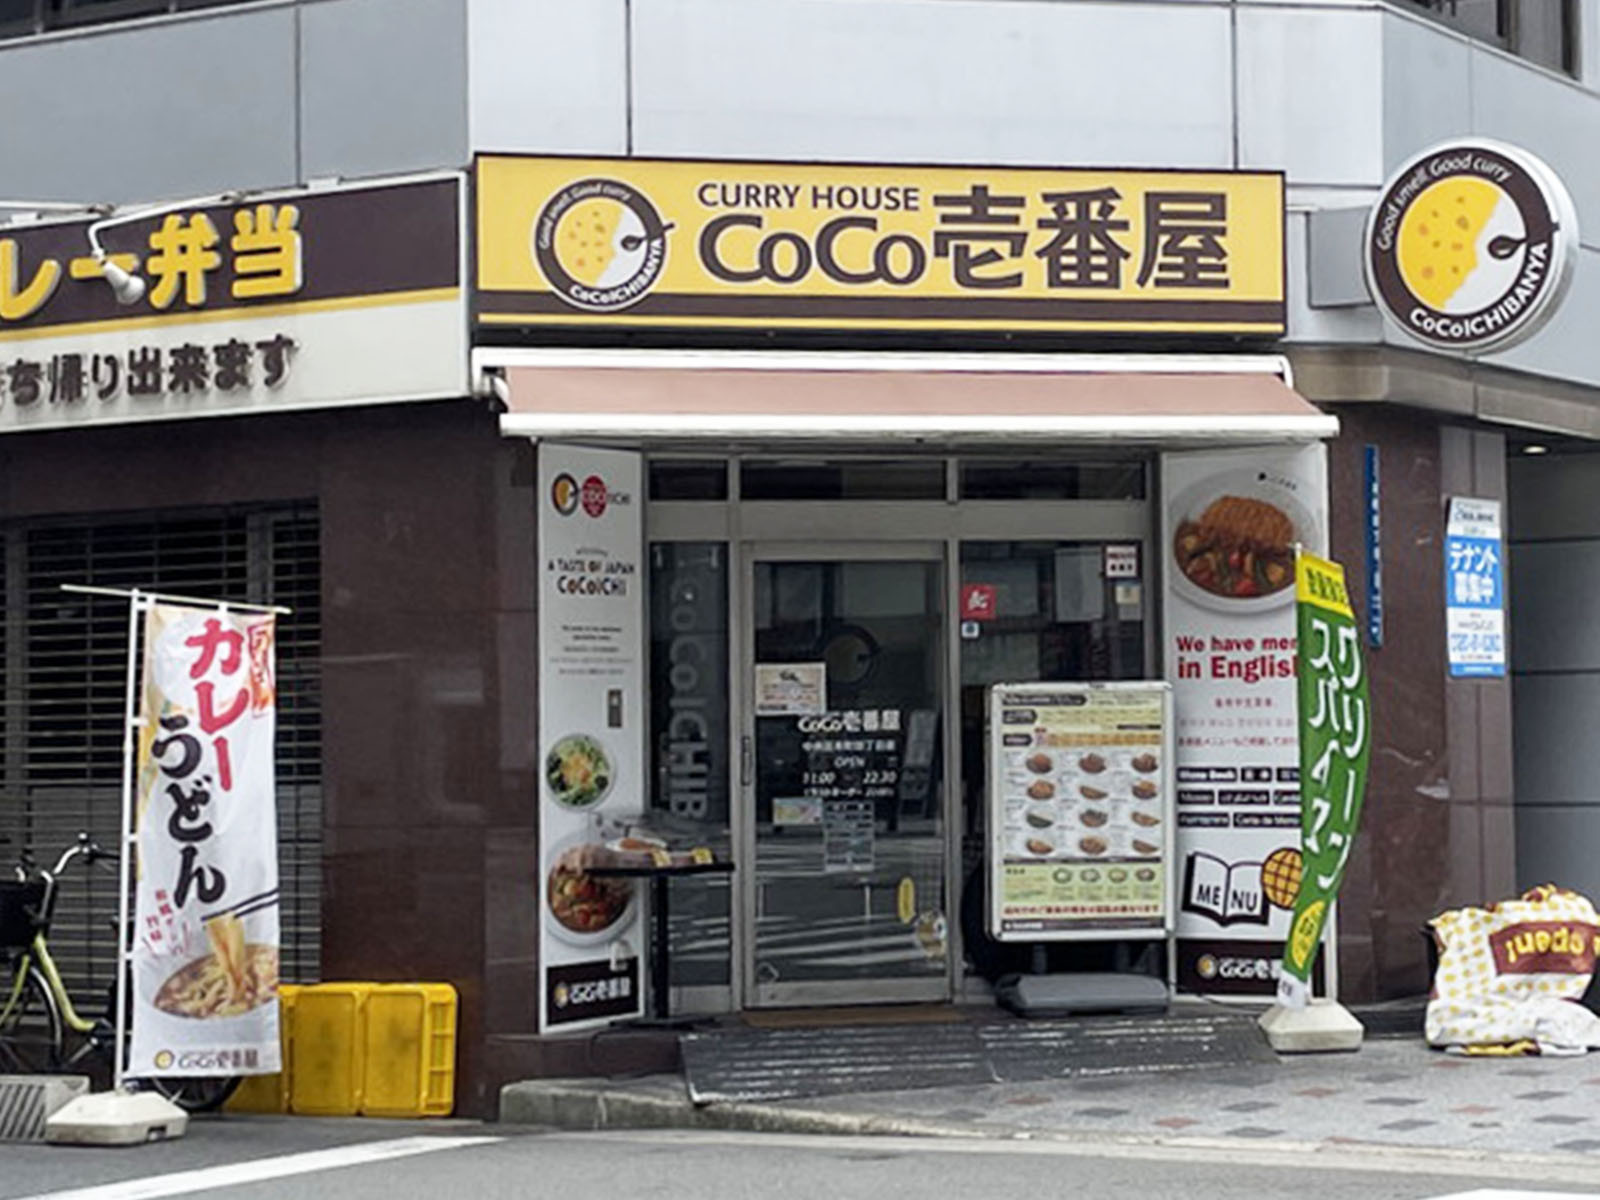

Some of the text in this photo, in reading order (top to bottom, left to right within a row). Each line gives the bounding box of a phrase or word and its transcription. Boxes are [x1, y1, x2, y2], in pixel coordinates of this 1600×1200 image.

[698, 183, 919, 212] CURRY HOUSE
[699, 185, 1230, 289] CoCo壱番屋
[0, 205, 303, 320] レー弁当
[0, 333, 299, 405] ち帰り出来ます
[1176, 636, 1205, 652] We
[1210, 636, 1256, 652] have
[1178, 656, 1201, 679] in
[184, 617, 250, 792] カレー
[151, 714, 226, 910] うどん
